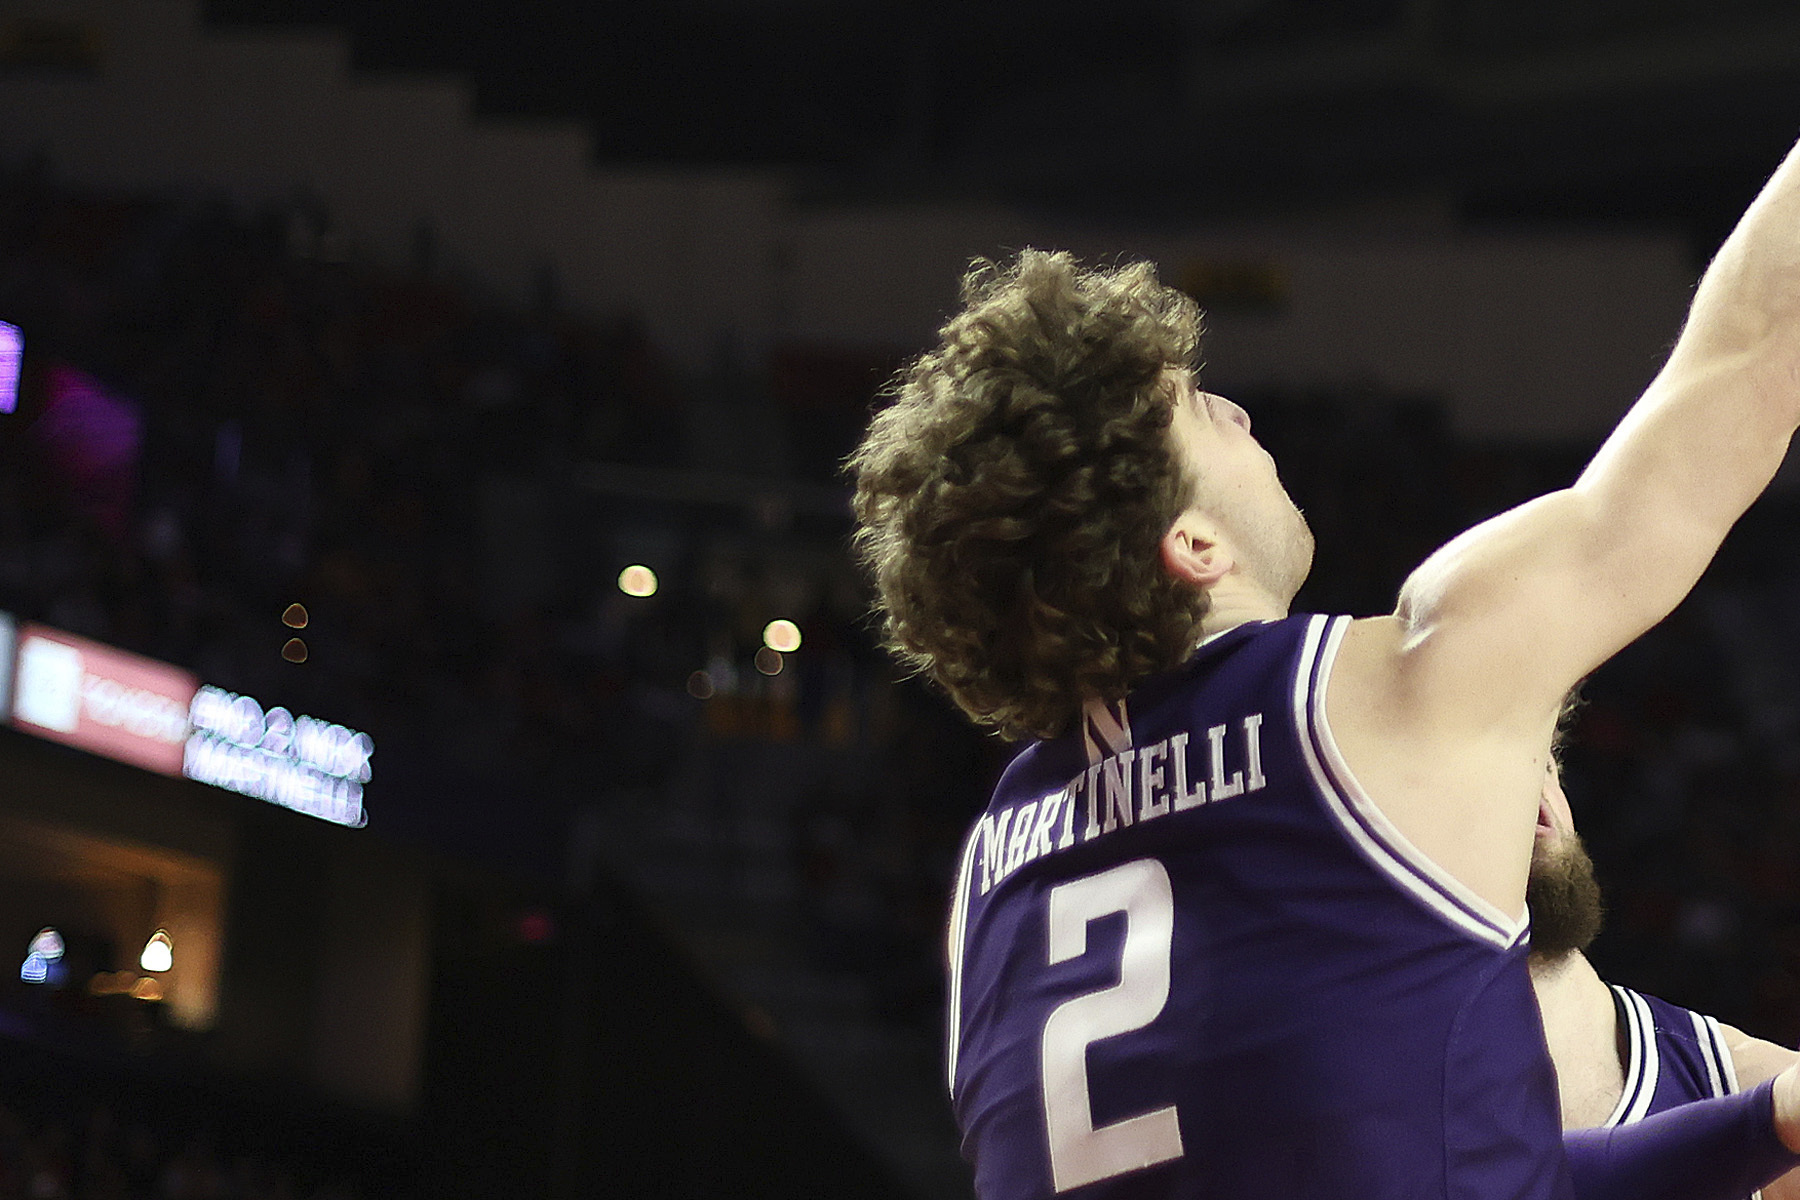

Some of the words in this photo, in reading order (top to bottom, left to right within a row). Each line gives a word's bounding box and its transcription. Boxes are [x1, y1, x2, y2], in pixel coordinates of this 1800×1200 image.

[978, 712, 1267, 897] MARTINELLI
[1082, 692, 1133, 767] N
[1041, 857, 1185, 1194] 2
